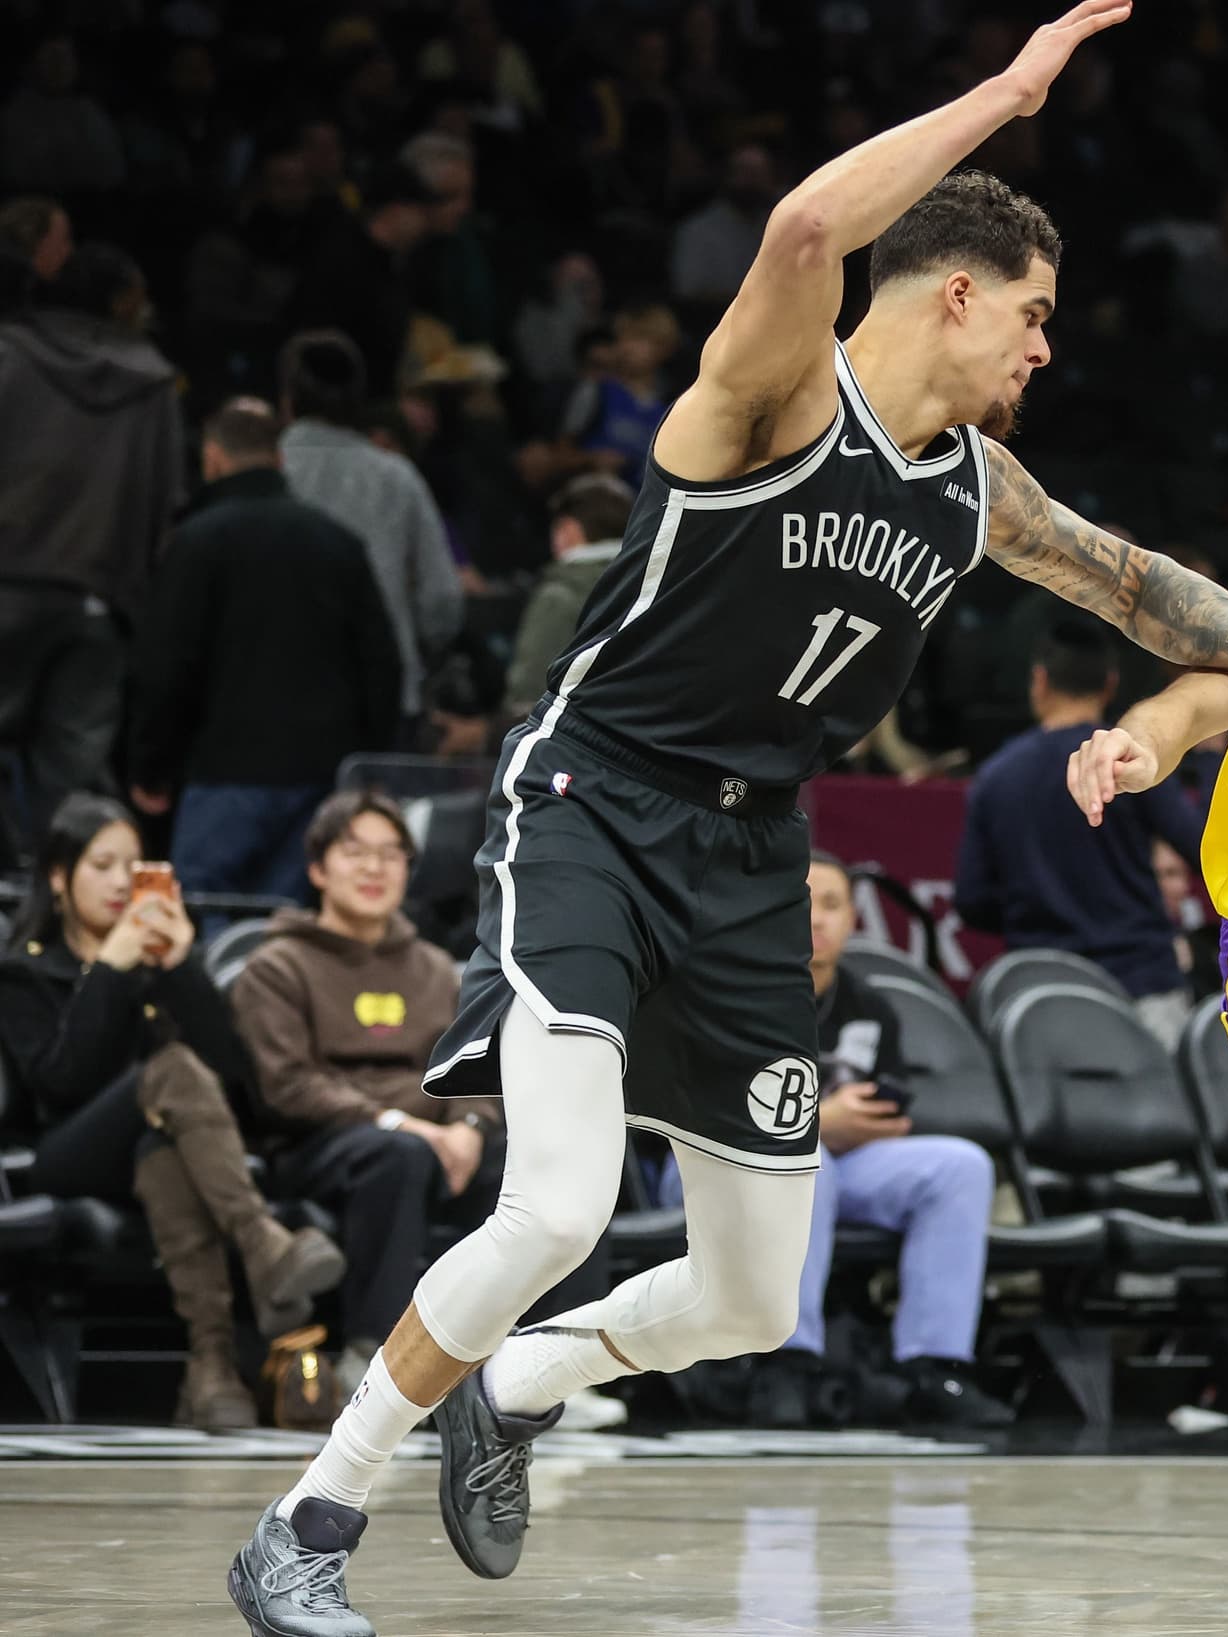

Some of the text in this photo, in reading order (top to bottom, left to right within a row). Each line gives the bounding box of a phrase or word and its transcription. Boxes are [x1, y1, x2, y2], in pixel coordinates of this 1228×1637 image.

[944, 482, 959, 500] All
[958, 487, 966, 504] In
[778, 607, 882, 706] 17
[722, 780, 745, 796] NETS
[773, 1067, 806, 1128] B
